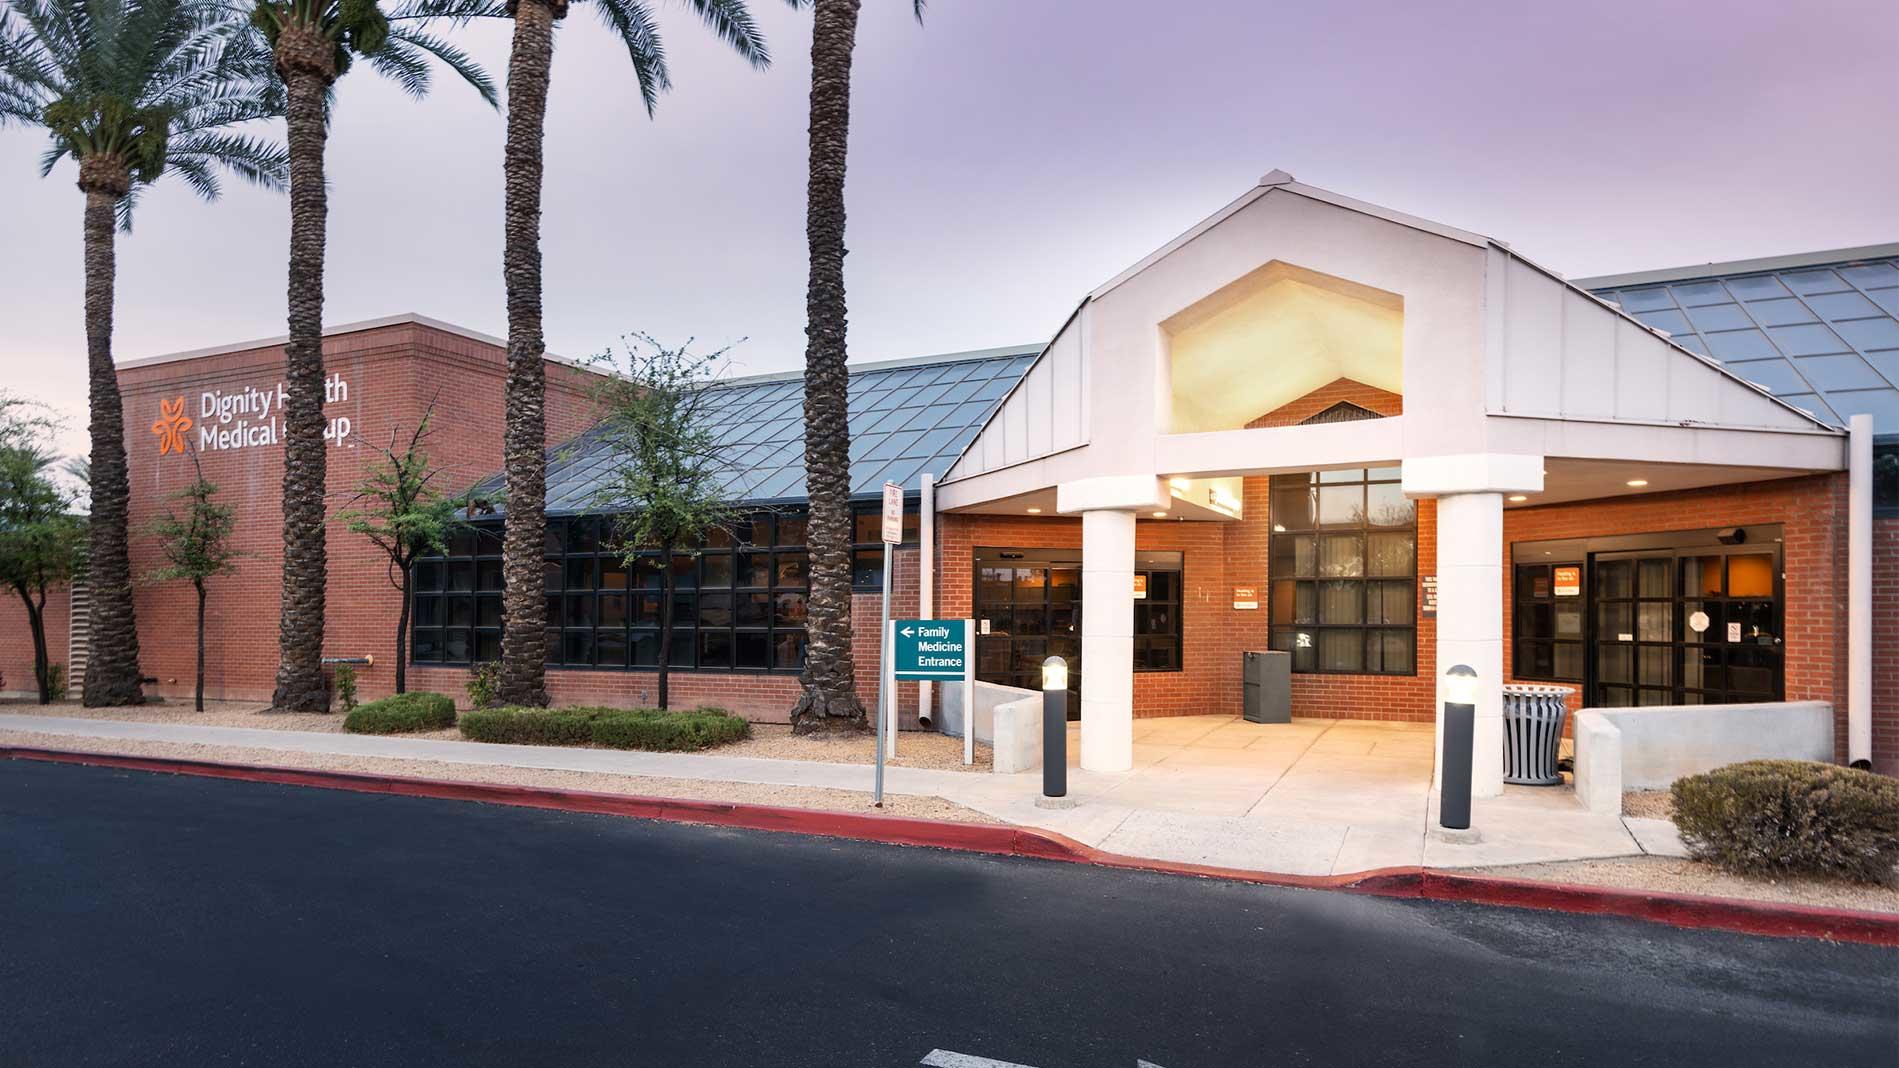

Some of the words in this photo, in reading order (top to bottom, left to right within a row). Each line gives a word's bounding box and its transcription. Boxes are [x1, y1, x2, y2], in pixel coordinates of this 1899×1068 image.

[201, 386, 273, 424] Dignity
[200, 416, 278, 451] Medical
[918, 626, 950, 639] Family
[918, 641, 963, 652] Medicine
[918, 656, 962, 667] Entrance
